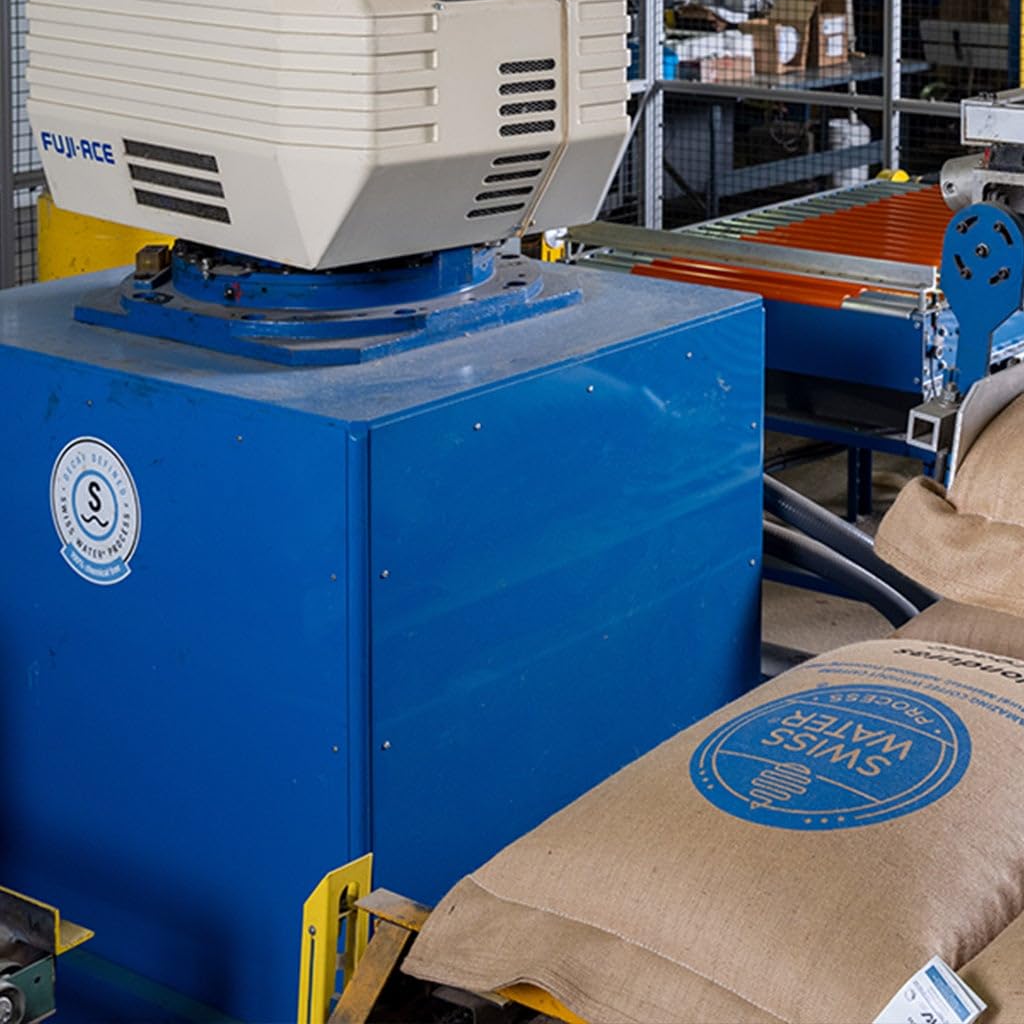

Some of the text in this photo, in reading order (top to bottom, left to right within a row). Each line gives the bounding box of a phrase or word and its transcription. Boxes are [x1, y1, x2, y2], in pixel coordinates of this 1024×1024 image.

[41, 131, 115, 164] FUJI-ACE
[60, 496, 76, 536] SWISS
[829, 692, 935, 725] PROCESS
[761, 727, 893, 776] SWISS
[781, 709, 913, 761] WATER
